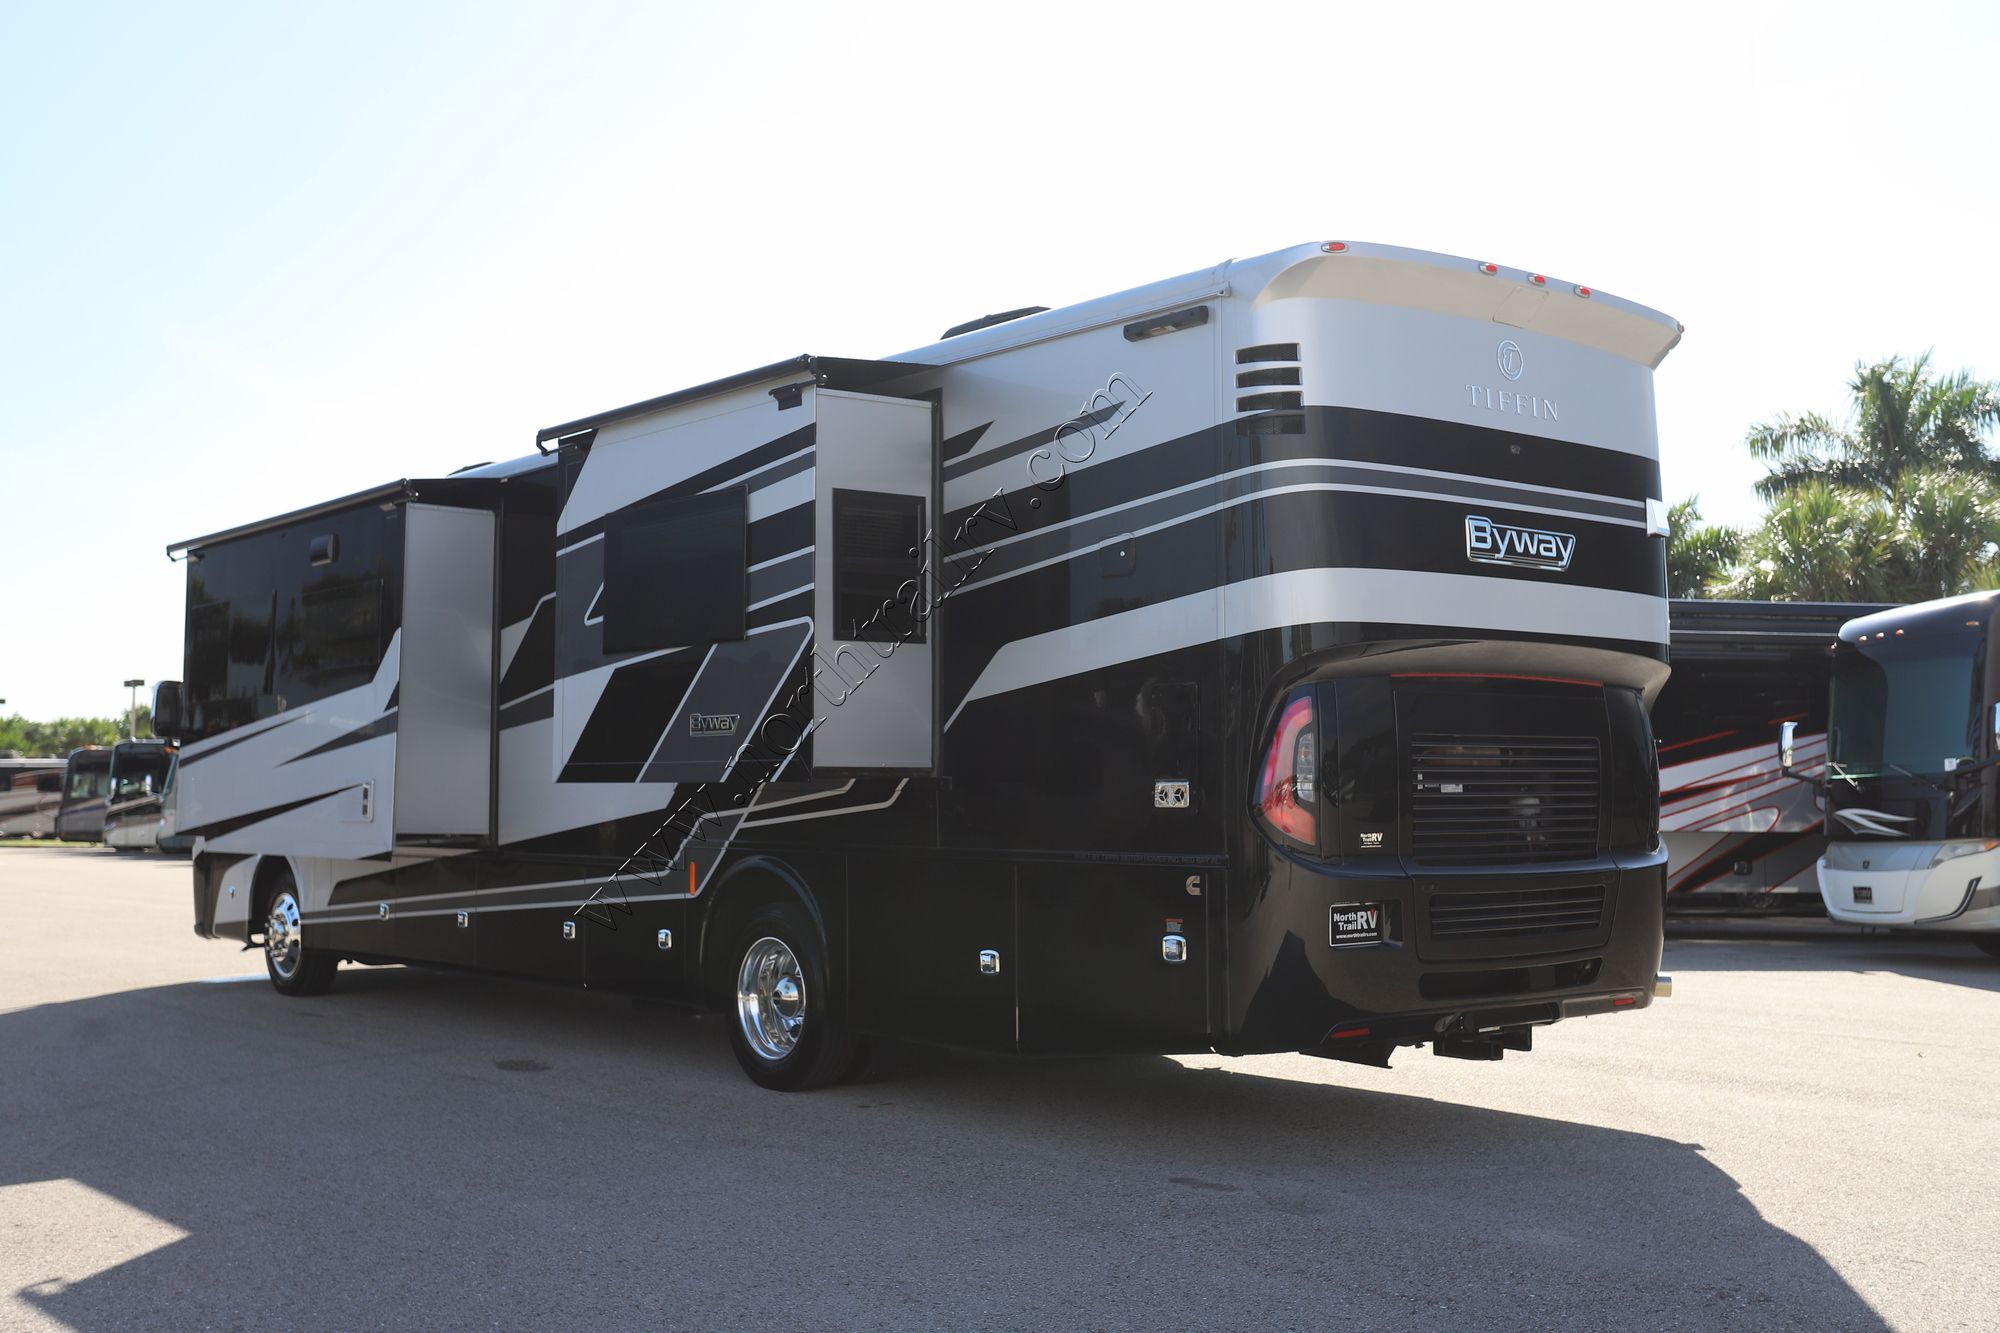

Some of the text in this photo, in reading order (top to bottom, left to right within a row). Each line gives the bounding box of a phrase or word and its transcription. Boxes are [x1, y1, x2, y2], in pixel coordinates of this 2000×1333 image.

[1465, 384, 1559, 422] TIFFIN
[1468, 519, 1574, 566] Byway
[691, 714, 737, 733] Byway
[1333, 912, 1357, 922] North
[1338, 921, 1357, 931] Trail
[1357, 909, 1377, 930] RV
